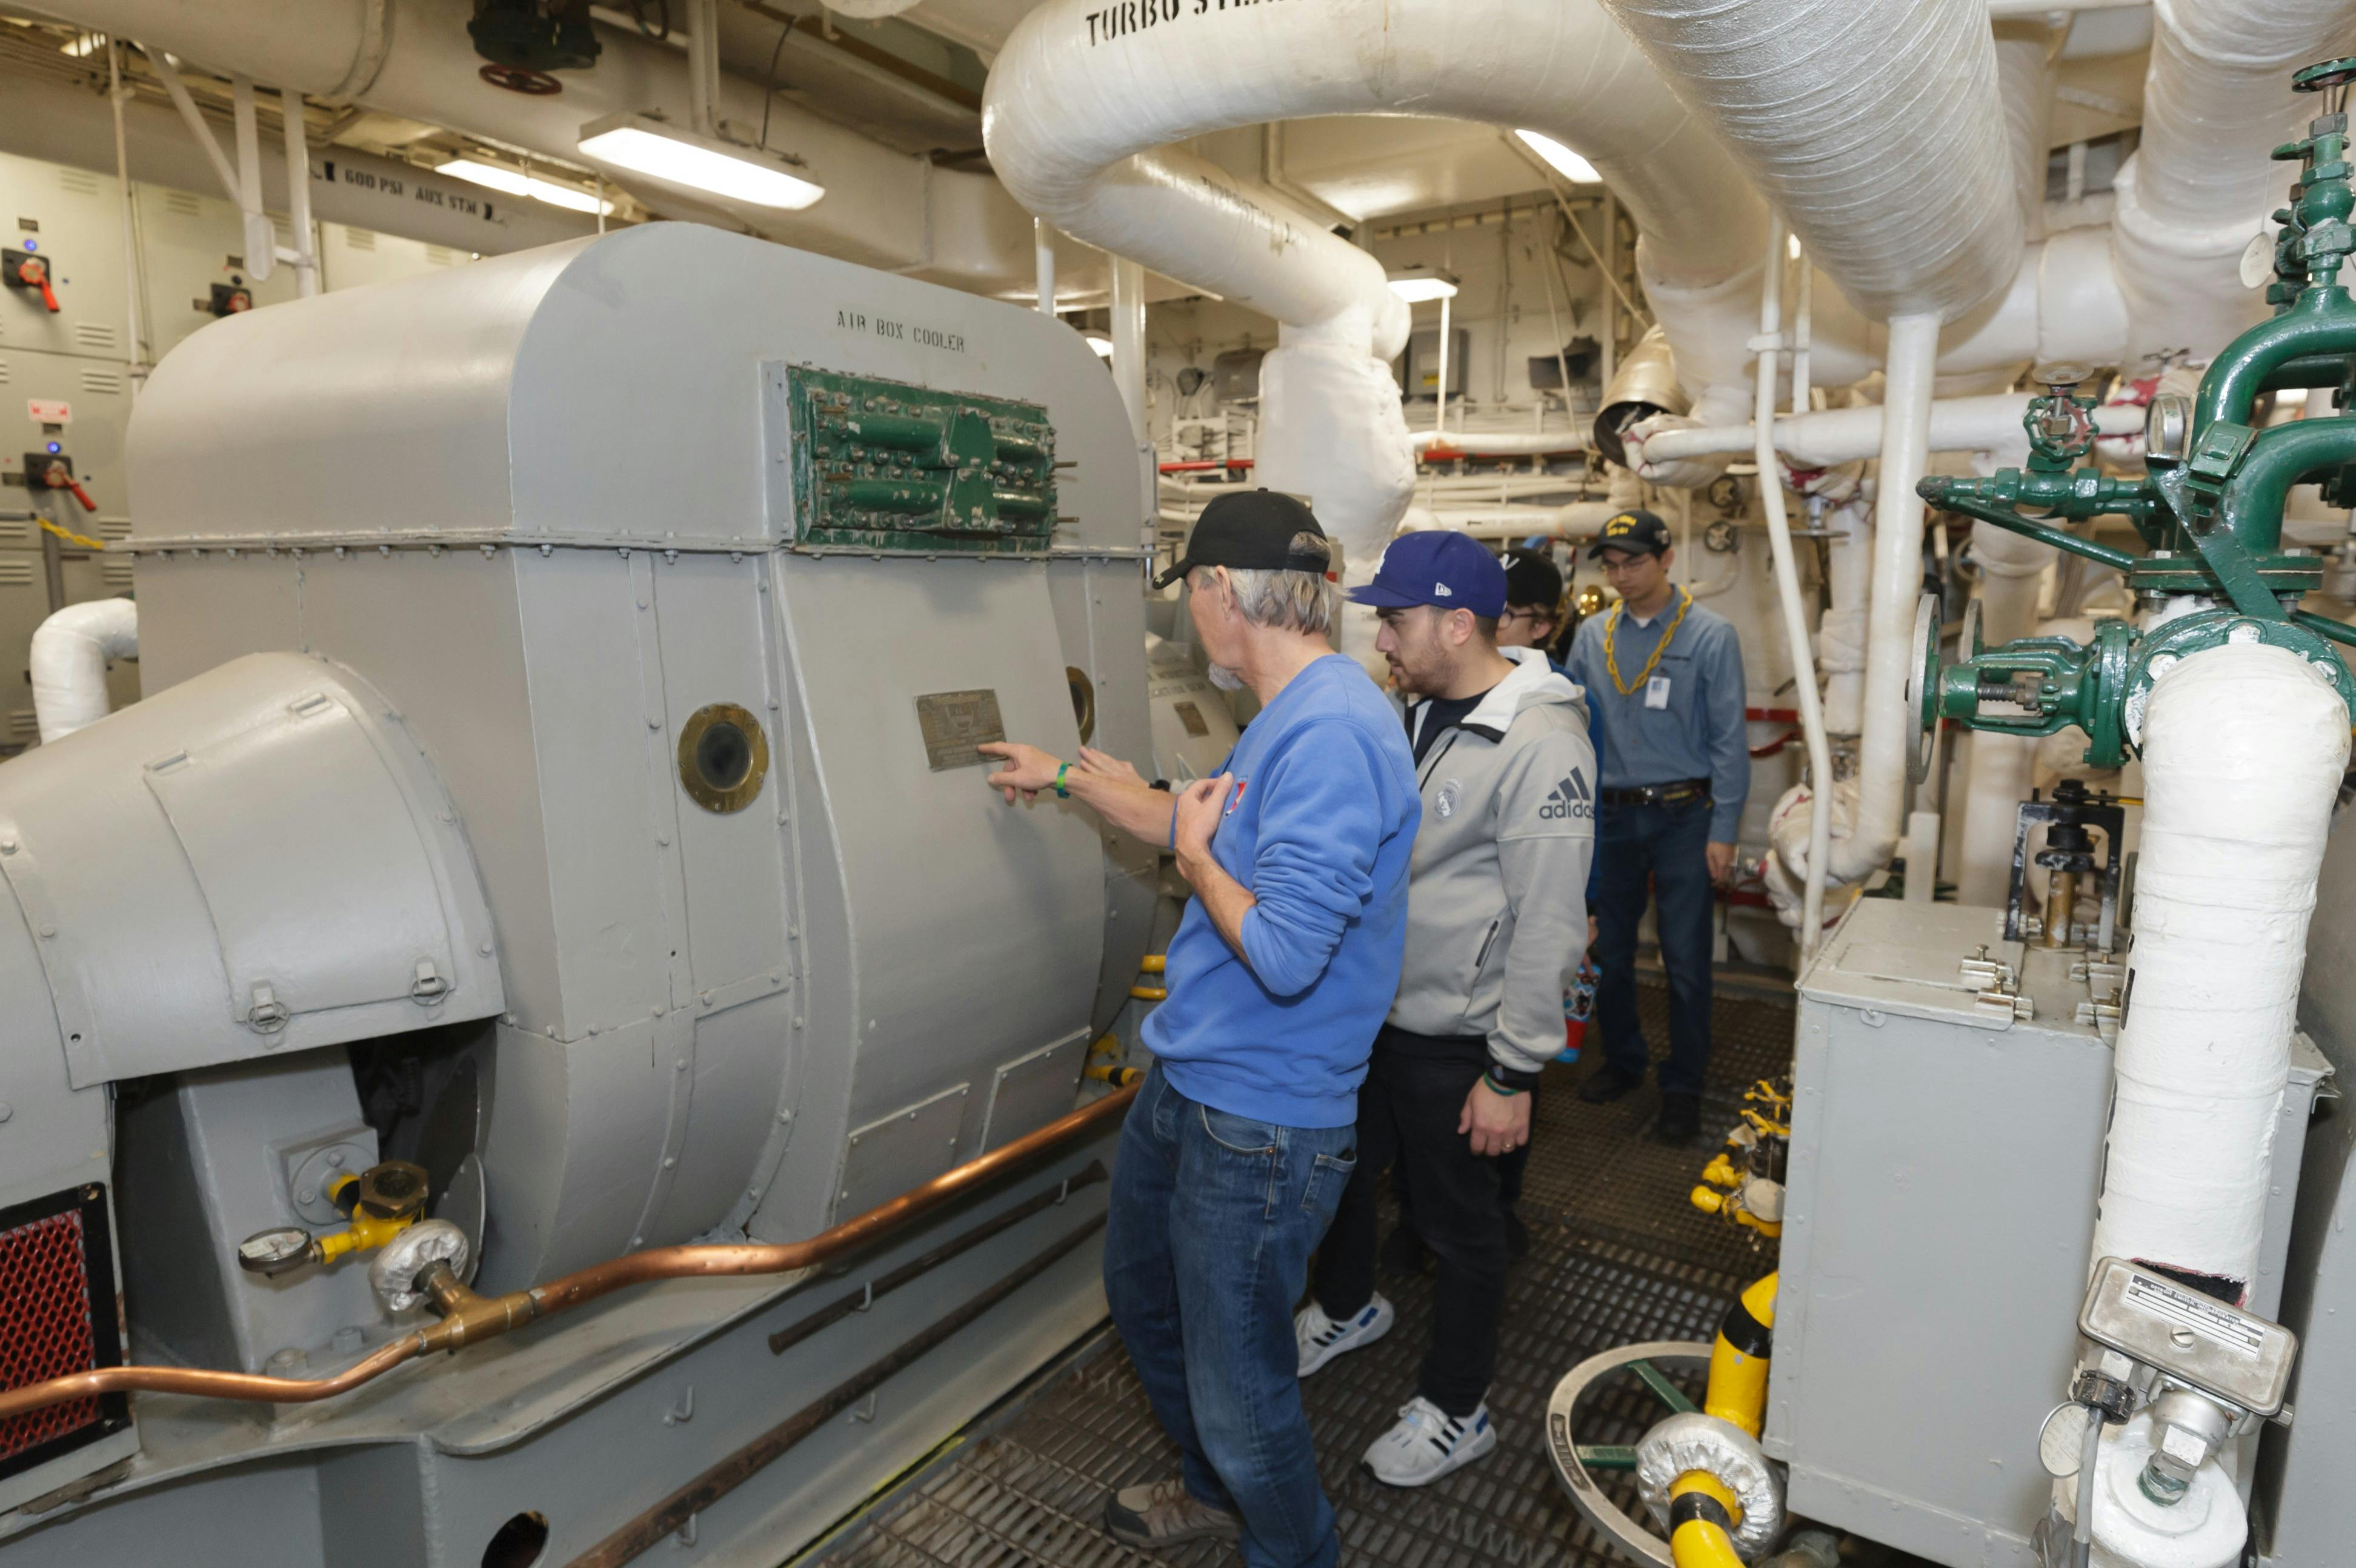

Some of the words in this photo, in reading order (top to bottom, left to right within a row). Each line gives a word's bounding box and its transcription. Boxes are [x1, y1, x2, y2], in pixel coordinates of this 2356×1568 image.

[1086, 0, 1179, 47] TURBO
[345, 169, 374, 188] 600
[380, 178, 402, 195] PSI
[416, 187, 443, 207] AUX
[449, 195, 476, 214] STM
[837, 310, 866, 331] AIR
[877, 318, 903, 340] BOX
[913, 327, 964, 353] COOLER
